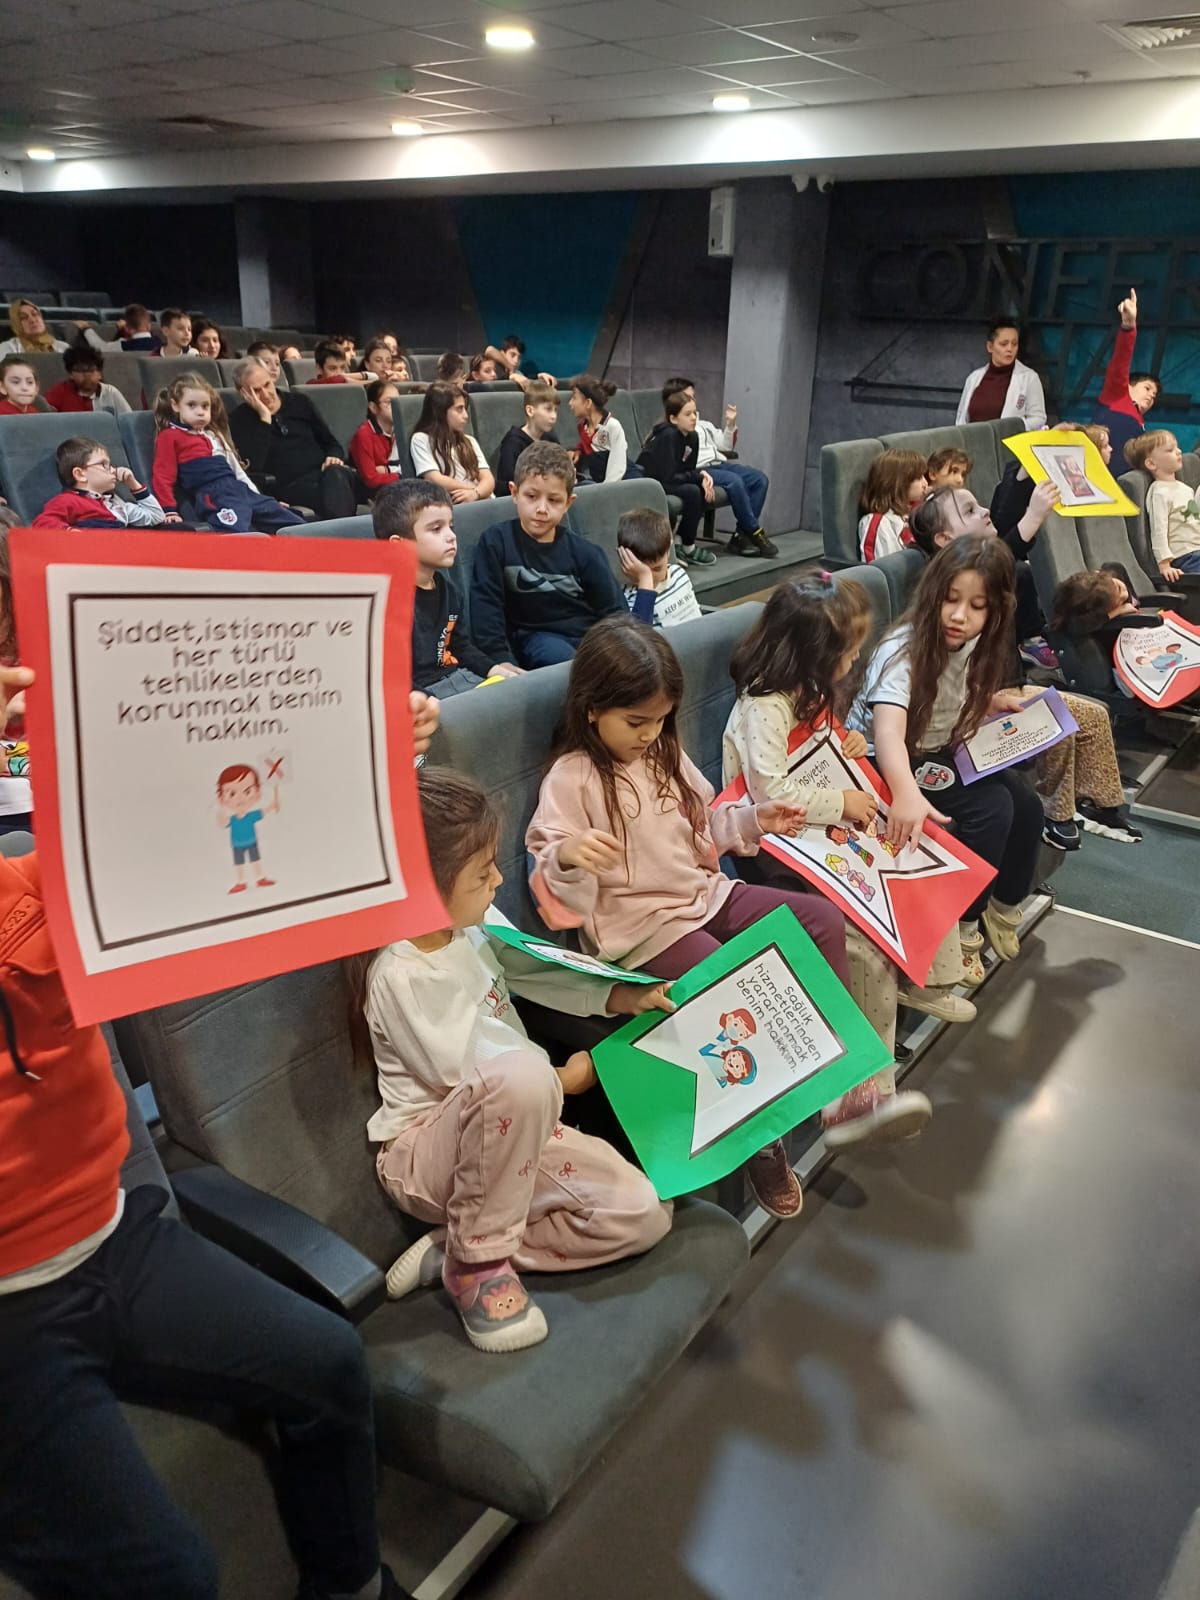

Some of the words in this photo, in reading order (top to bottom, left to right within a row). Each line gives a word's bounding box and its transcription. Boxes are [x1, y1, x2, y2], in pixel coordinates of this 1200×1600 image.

[326, 619, 353, 638] ve
[172, 645, 222, 669] her
[231, 640, 296, 665] türlü
[141, 664, 323, 696] tehlikelerden
[116, 691, 262, 726] korunmak
[269, 687, 343, 712] benim
[185, 716, 289, 744] hakkım.
[736, 978, 765, 1020] benim
[754, 963, 821, 1061] hizmetlerinden
[784, 985, 814, 1026] Sağlık
[745, 976, 808, 1063] yararlanmak
